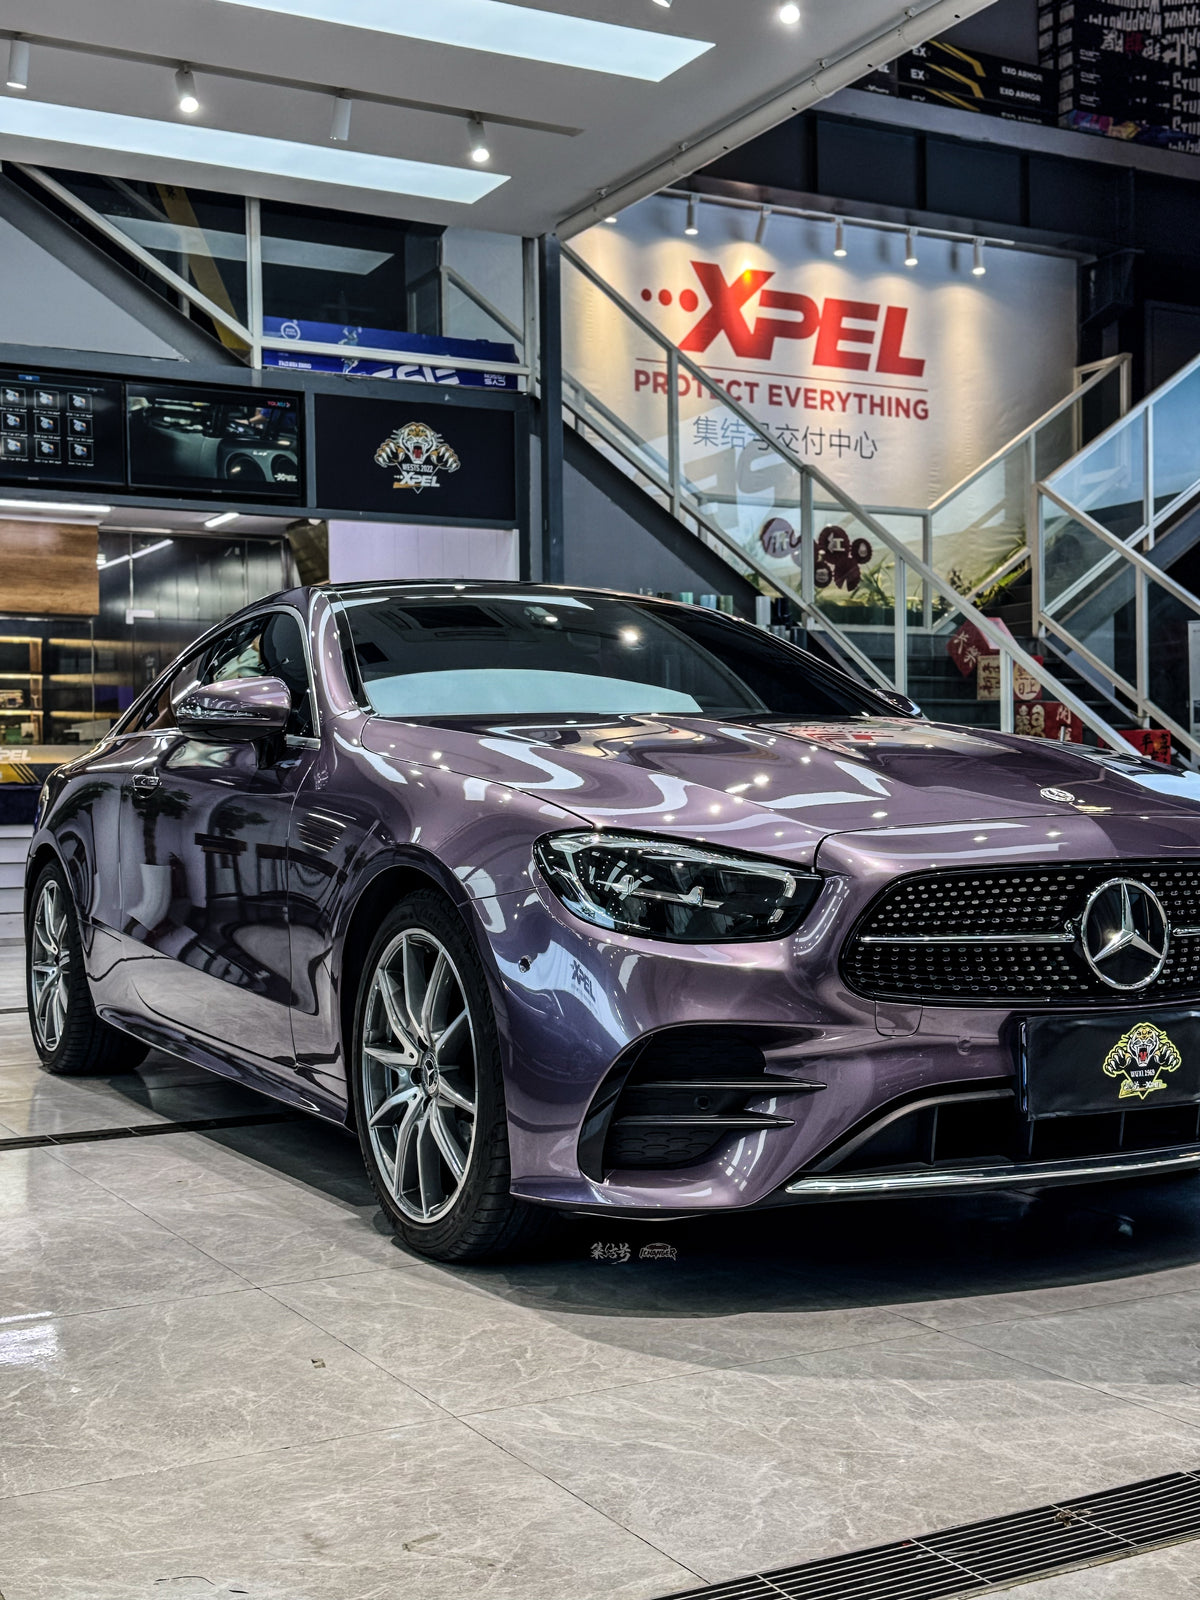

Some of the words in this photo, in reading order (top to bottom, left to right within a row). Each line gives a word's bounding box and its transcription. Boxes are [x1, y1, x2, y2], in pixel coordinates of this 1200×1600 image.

[1017, 69, 1044, 83] ARMOR
[1015, 90, 1042, 102] ARMOR
[678, 260, 926, 377] XPEL
[633, 369, 760, 404] PROTCT
[768, 384, 929, 421] EVERYTHING
[400, 471, 440, 488] XPEL
[0, 747, 31, 761] PEL
